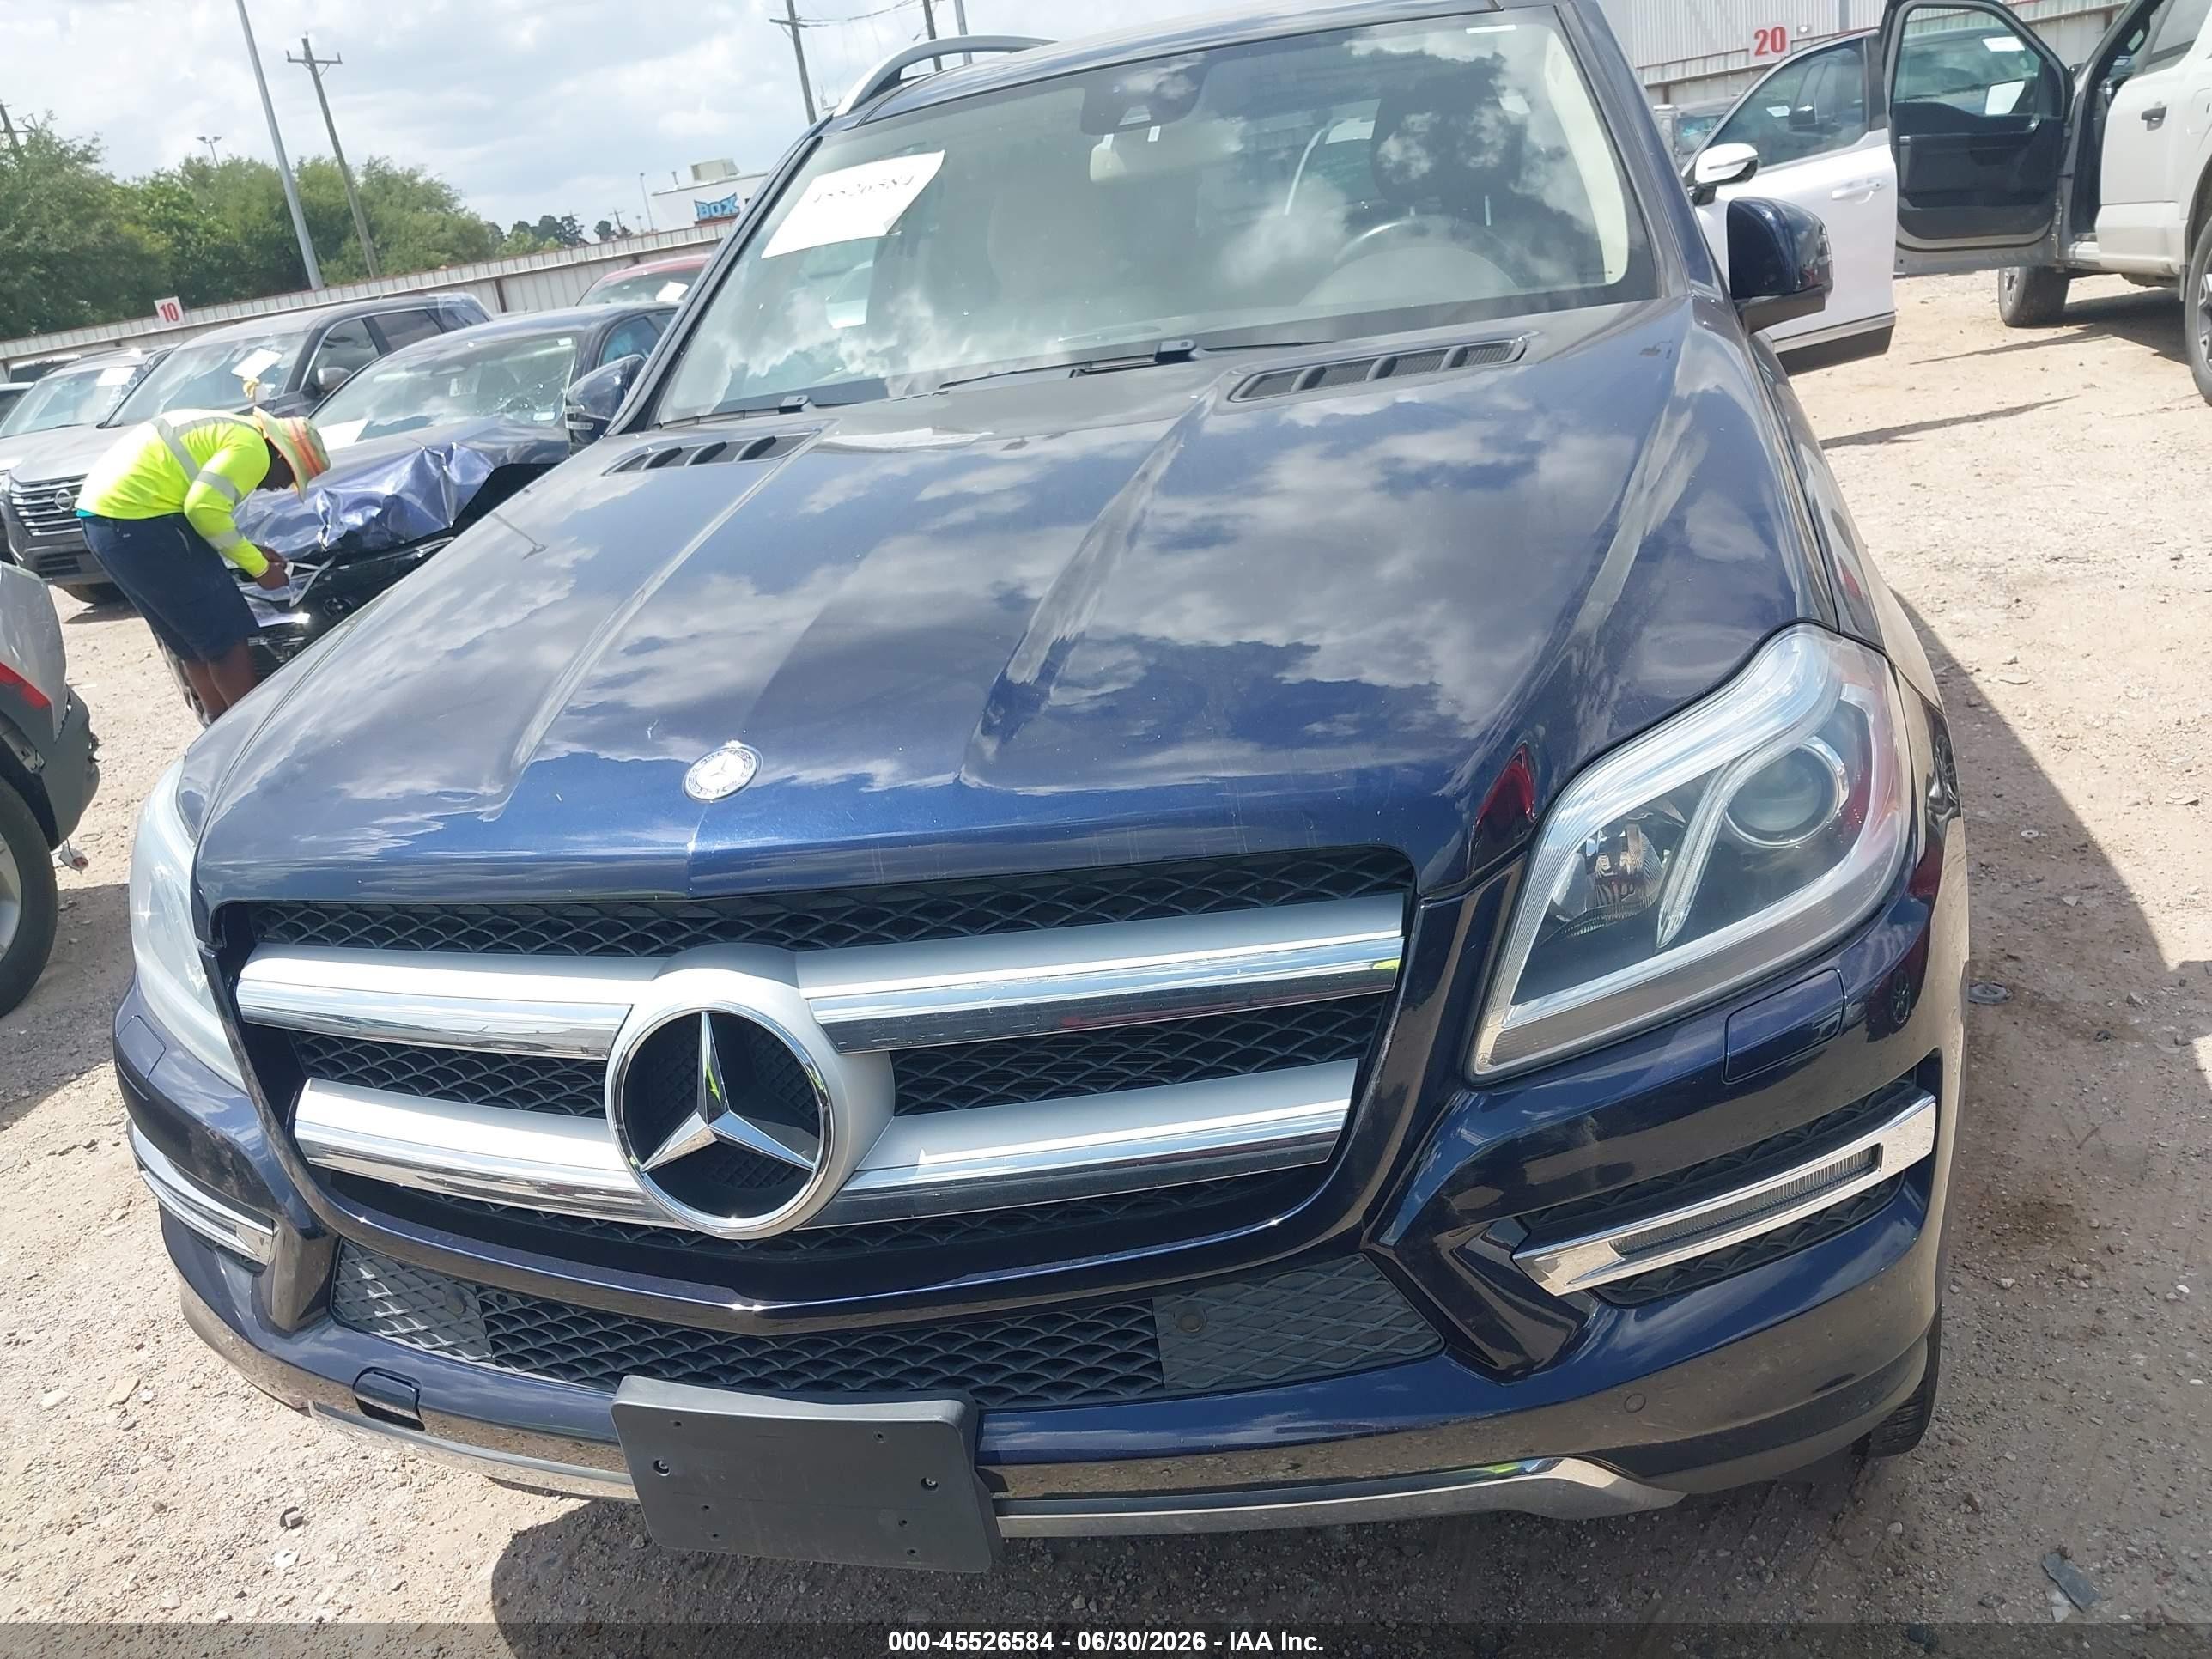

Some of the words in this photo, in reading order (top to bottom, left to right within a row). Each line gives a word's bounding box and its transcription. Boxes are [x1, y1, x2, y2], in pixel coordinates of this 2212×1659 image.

[1753, 26, 1786, 57] 20
[697, 197, 738, 218] BOX
[160, 302, 179, 323] 10
